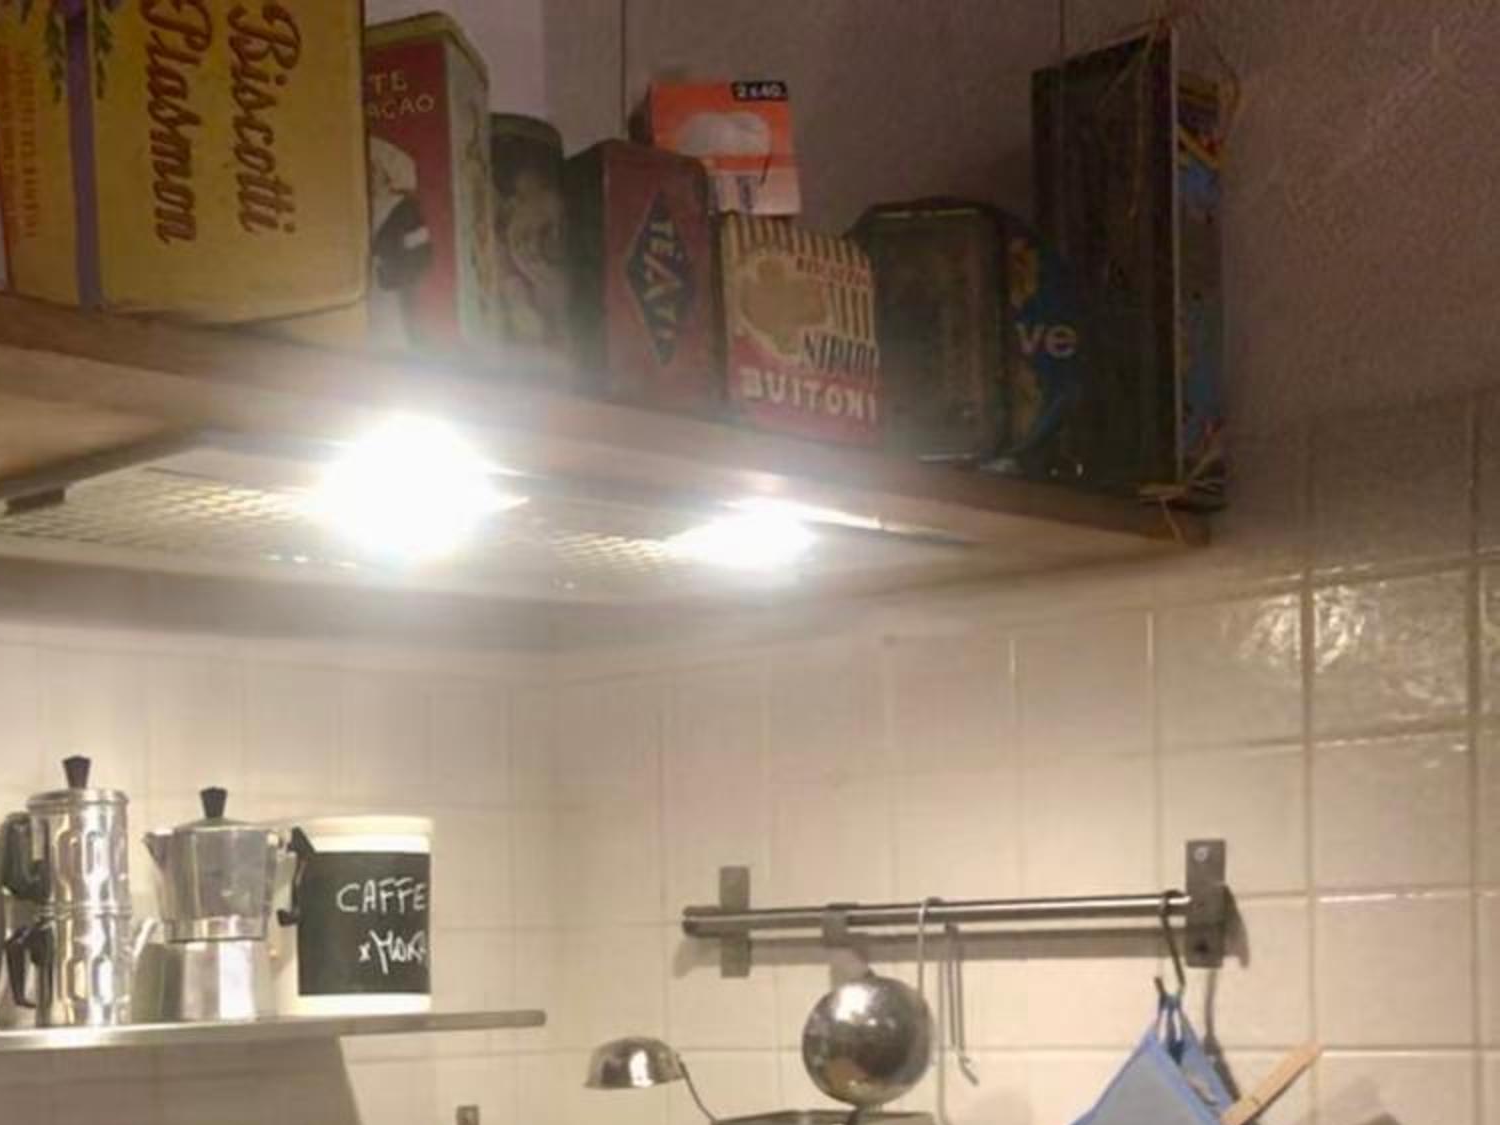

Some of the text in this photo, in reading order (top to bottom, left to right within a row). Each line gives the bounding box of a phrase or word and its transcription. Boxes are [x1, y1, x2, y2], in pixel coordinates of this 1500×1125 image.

[140, 0, 213, 246] Plasmon
[227, 3, 301, 235] Biscotti
[738, 367, 878, 424] BUITONI
